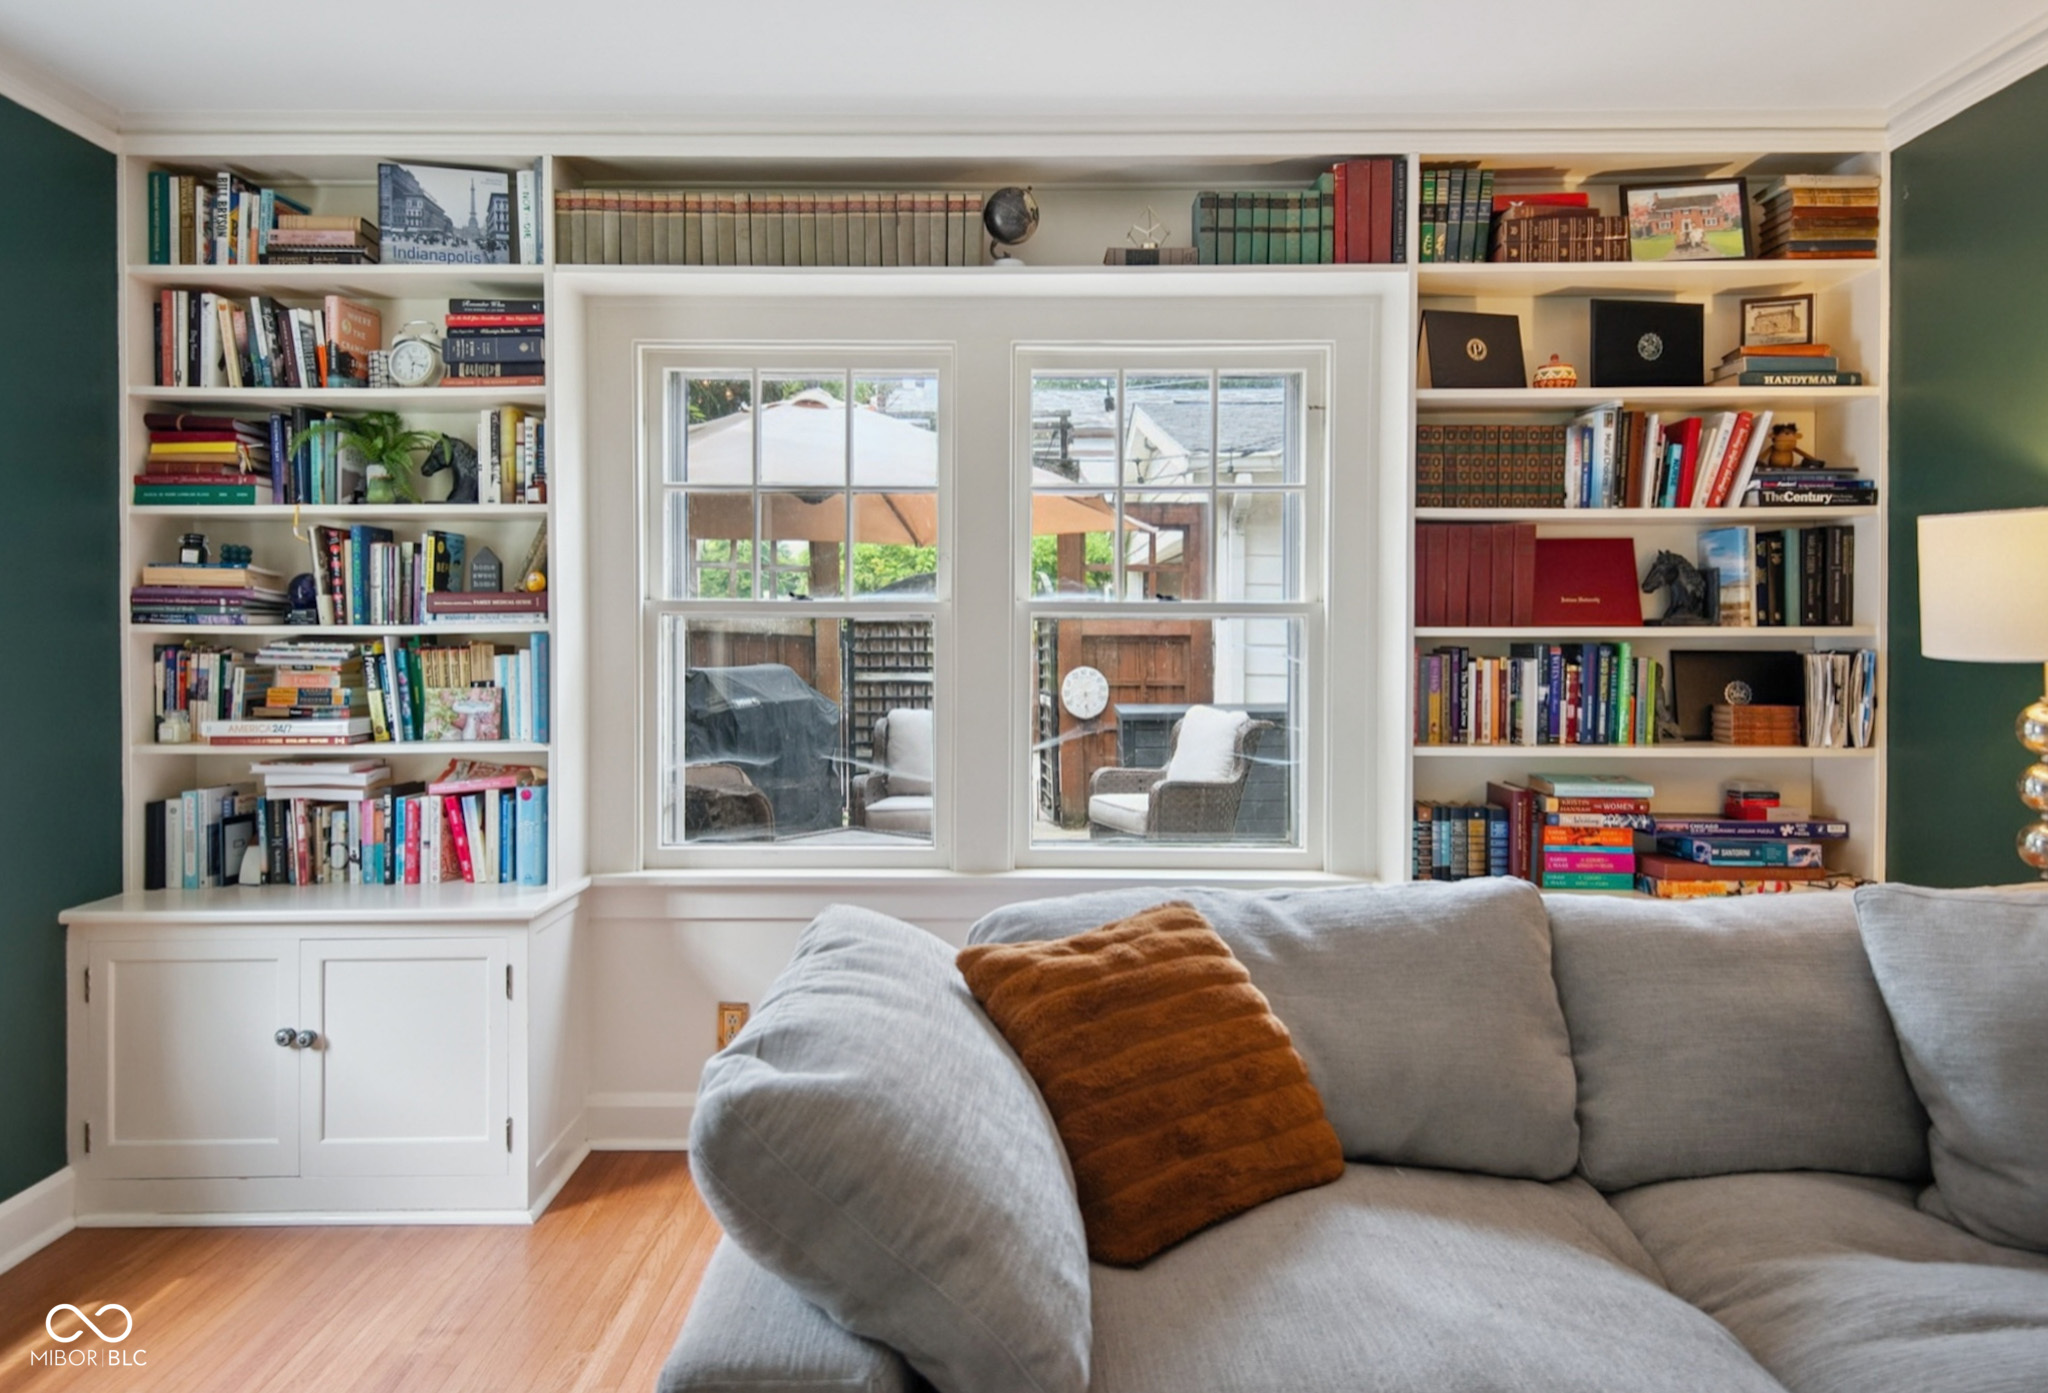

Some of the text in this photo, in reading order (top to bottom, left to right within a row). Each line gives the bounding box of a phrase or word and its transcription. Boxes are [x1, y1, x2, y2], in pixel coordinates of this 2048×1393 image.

[216, 177, 228, 238] BILL BRYSON
[522, 191, 530, 212] NOT
[523, 222, 531, 239] DIE
[392, 245, 481, 264] Indianapolis
[347, 312, 372, 327] WHERE
[352, 330, 366, 341] THE
[301, 333, 316, 370] MIDDLESEX
[1764, 376, 1837, 384] HANDYMAN
[1602, 434, 1612, 486] Moral Choices
[1670, 458, 1680, 487] NURSE
[472, 562, 496, 570] home
[364, 656, 377, 689] France
[228, 724, 292, 734] AMERICA 24/7
[1721, 848, 1750, 857] SANTORINI
